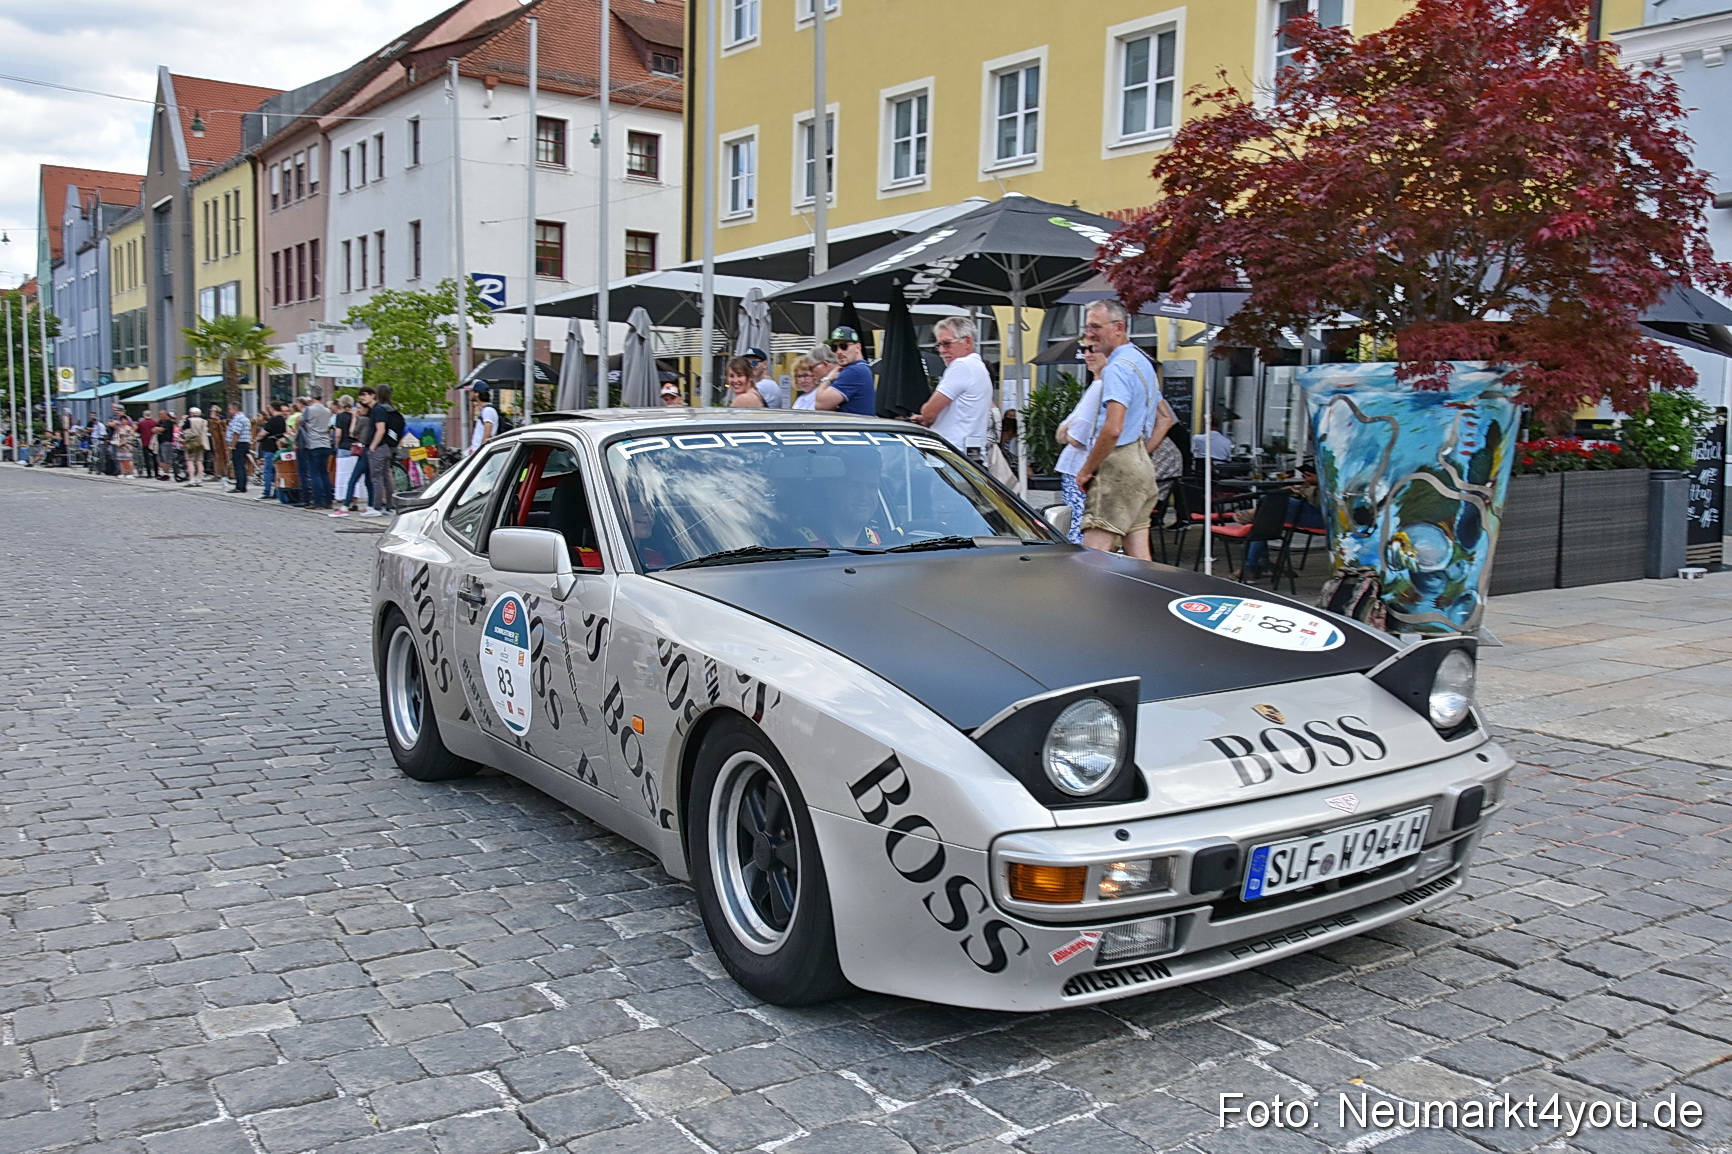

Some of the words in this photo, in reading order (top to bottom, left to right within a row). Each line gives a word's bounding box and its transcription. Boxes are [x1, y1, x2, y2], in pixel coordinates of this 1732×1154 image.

[475, 278, 505, 306] R
[616, 431, 949, 460] PORSCHE
[411, 562, 453, 694] BOSS
[1258, 615, 1297, 634] 83
[497, 665, 514, 697] 83
[557, 604, 588, 726] PORSCHE
[462, 659, 492, 728] BILSTEIN
[1203, 715, 1387, 788] BOSS
[846, 748, 1030, 974] BOSS
[1267, 841, 1326, 889] SLF
[1396, 877, 1456, 907] BILSTEIN
[1229, 914, 1360, 959] PORSCHE
[1063, 961, 1173, 997] BILSTEIN
